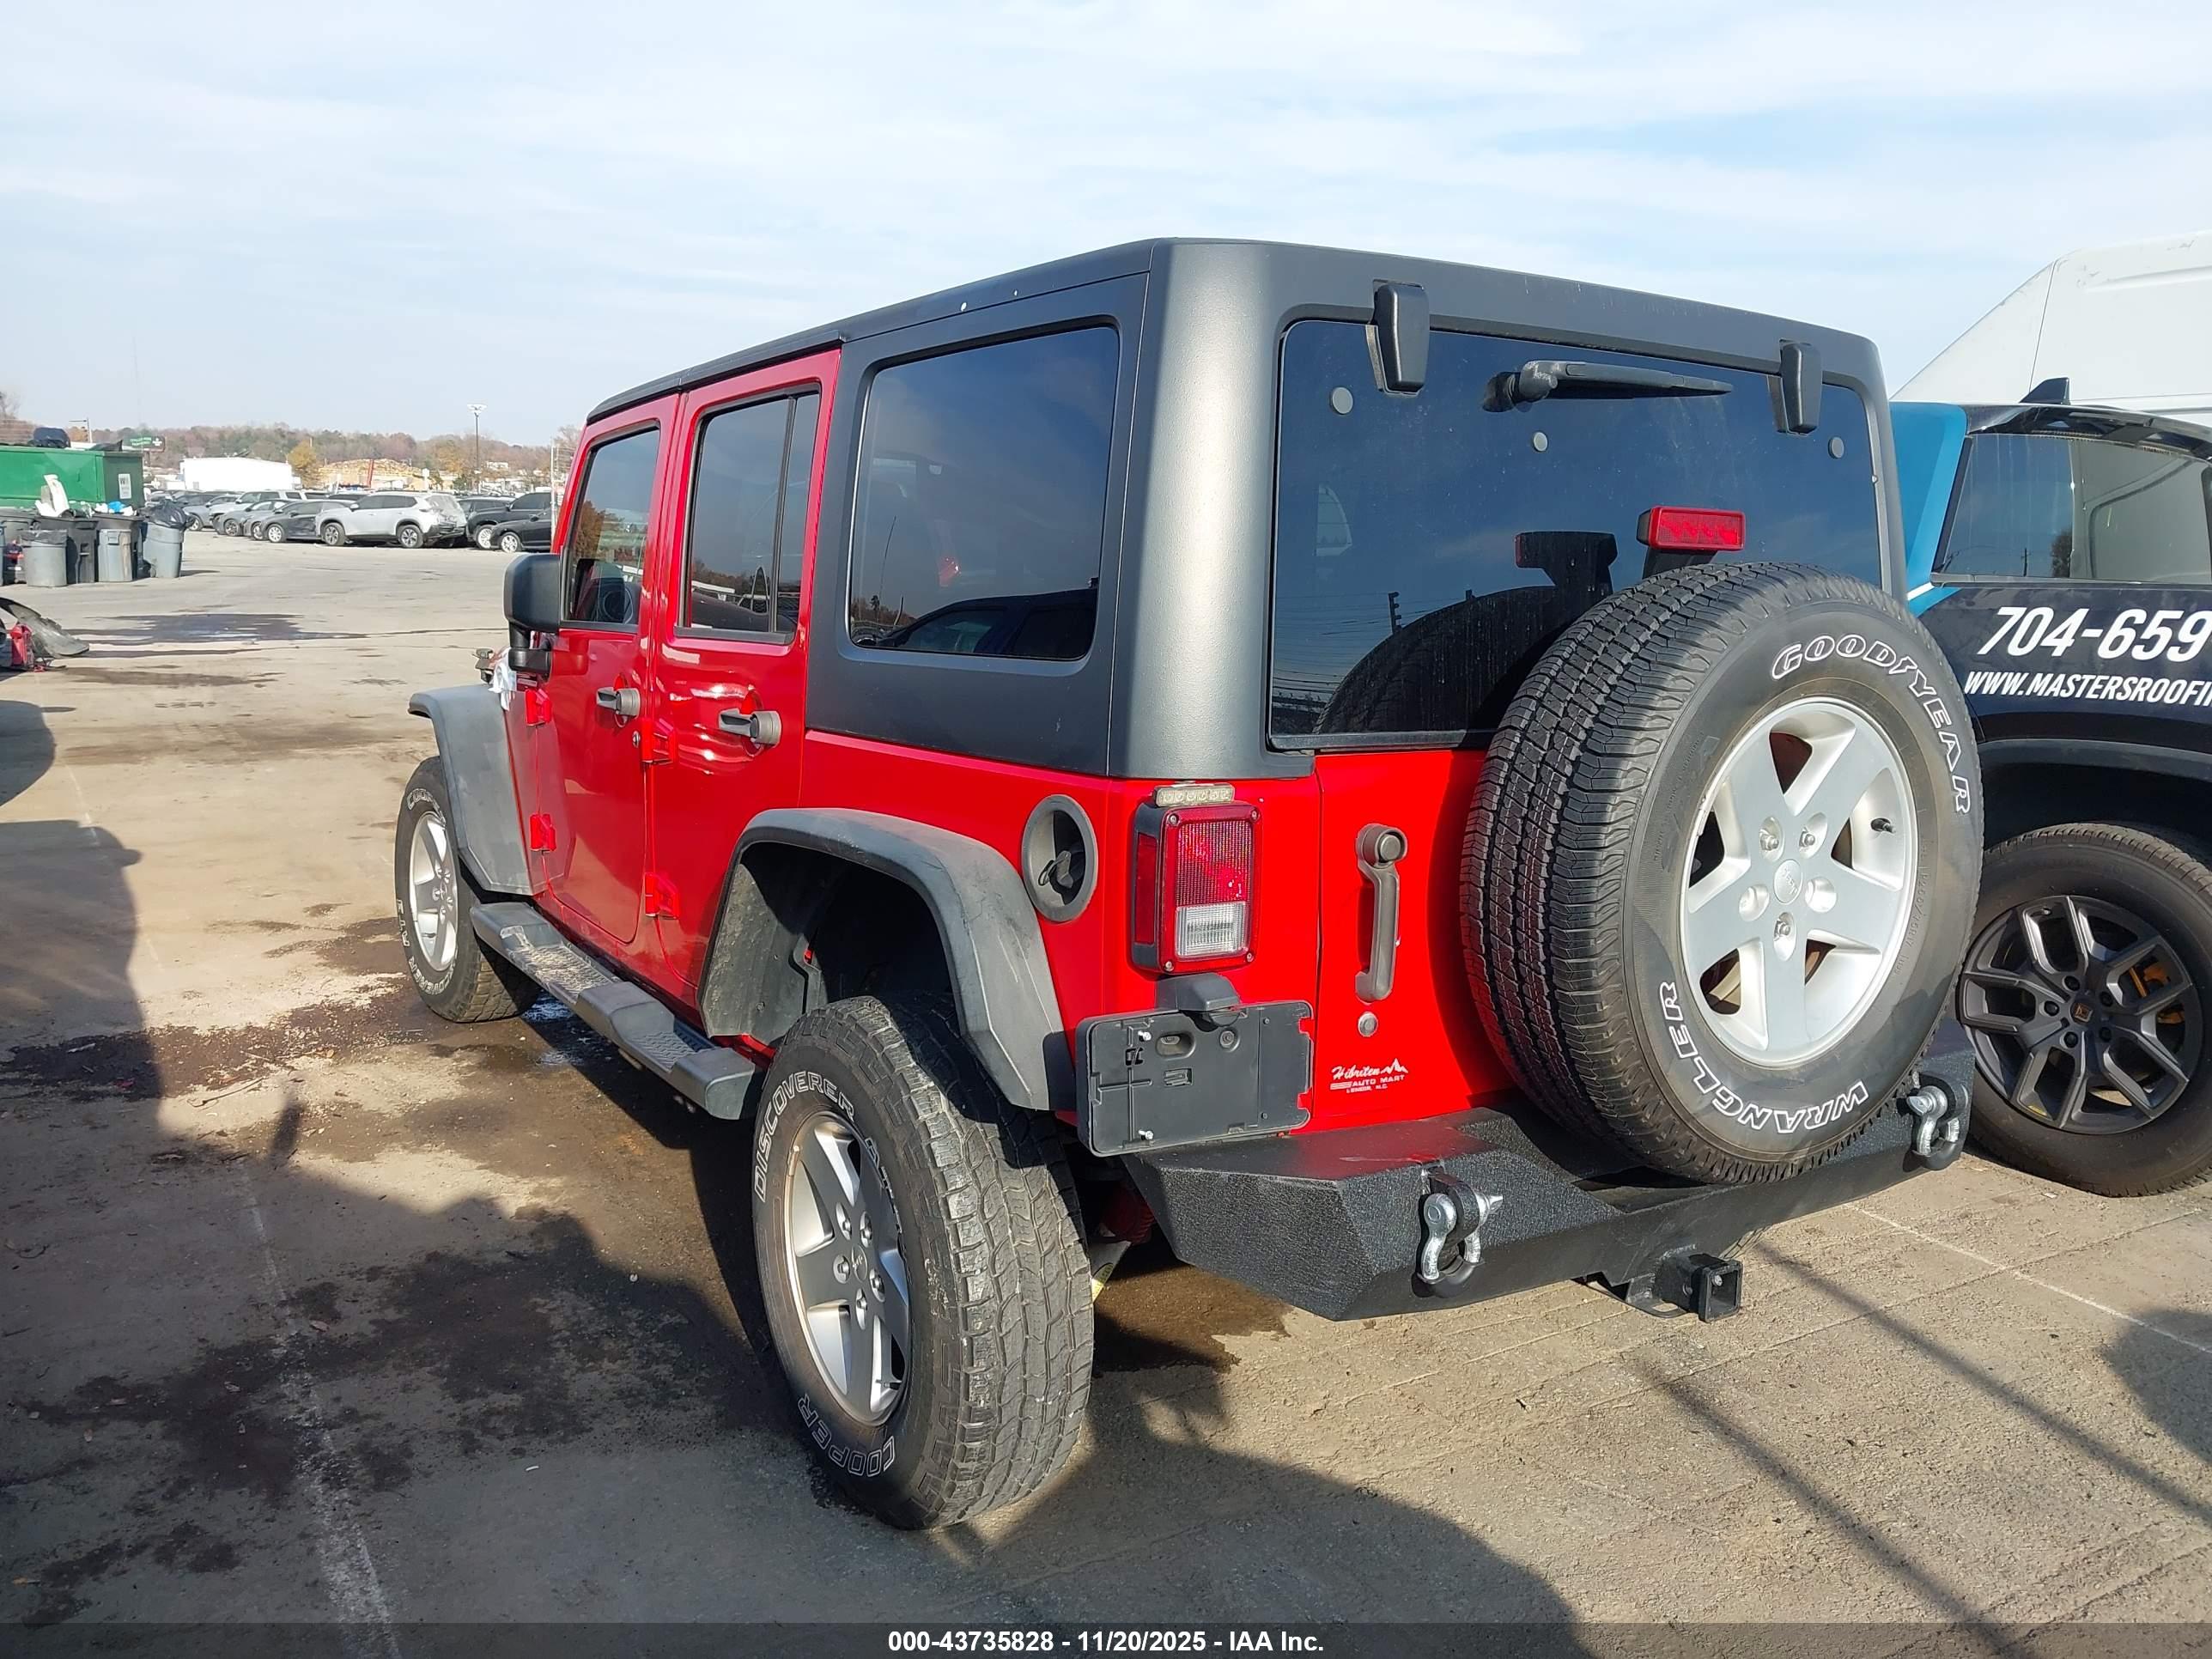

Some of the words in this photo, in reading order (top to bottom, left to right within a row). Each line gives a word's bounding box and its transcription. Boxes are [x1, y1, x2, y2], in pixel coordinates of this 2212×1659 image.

[1977, 606, 2212, 662] 704-659
[1771, 634, 1971, 813] GOODYEAR
[1380, 1074, 1405, 1083] MART
[1659, 981, 1869, 1134] WRANGLER
[754, 1070, 855, 1203] DISCOVERER
[797, 1392, 896, 1478] COOPER
